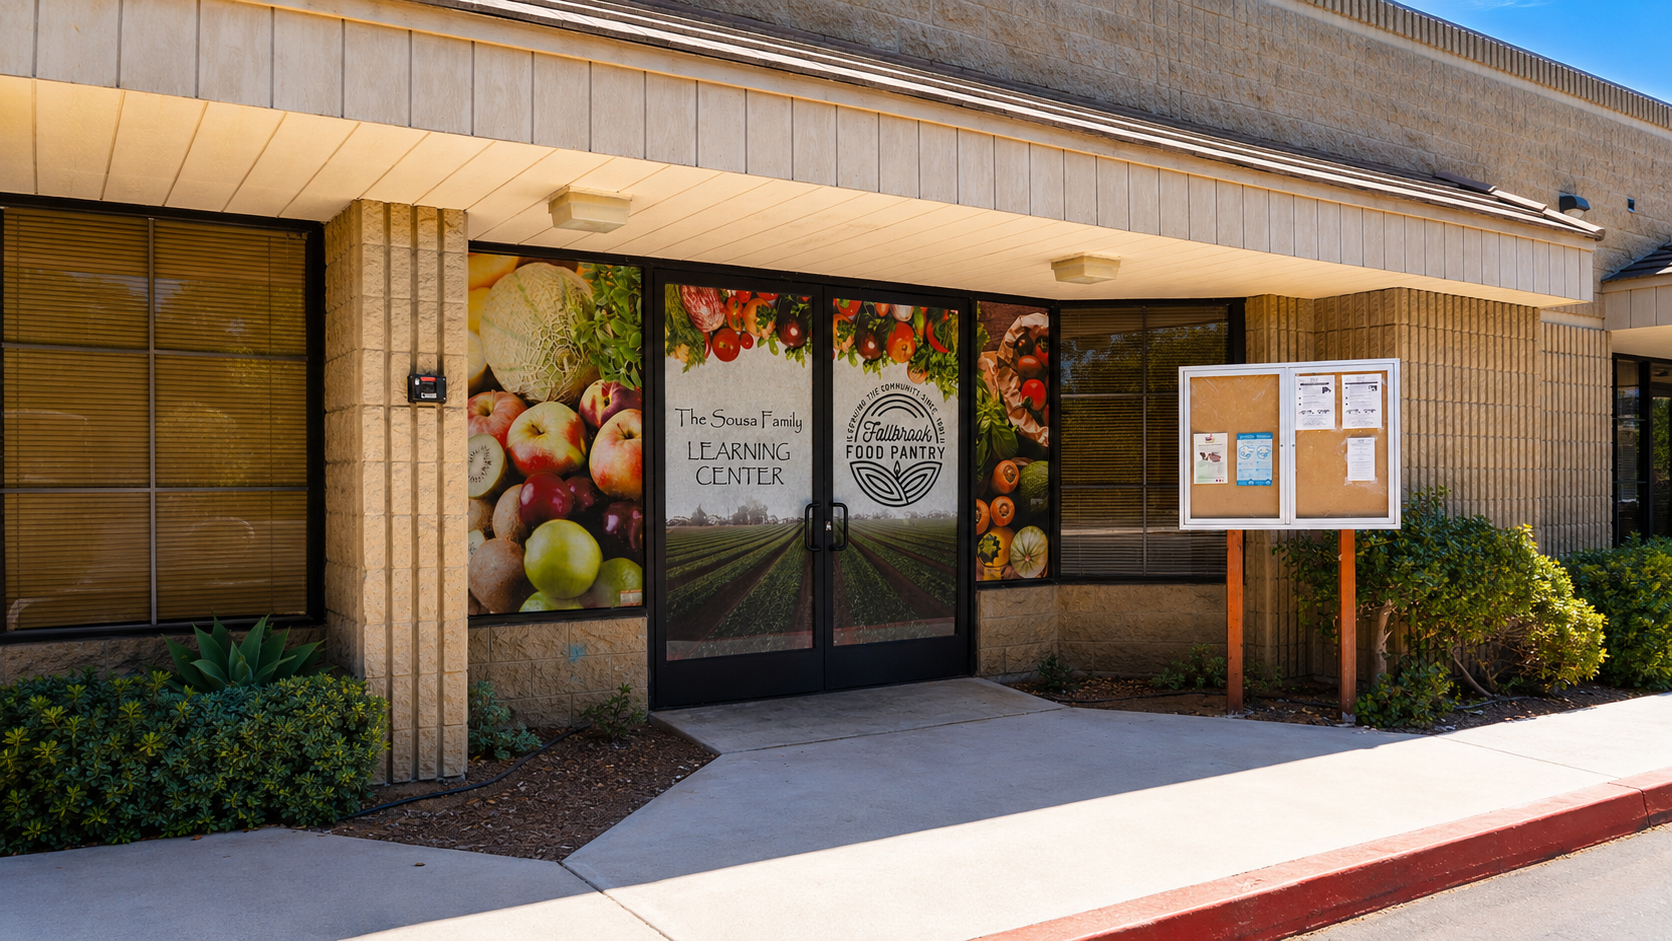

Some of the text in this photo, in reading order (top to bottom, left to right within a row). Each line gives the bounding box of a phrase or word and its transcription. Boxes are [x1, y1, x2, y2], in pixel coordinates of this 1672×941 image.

[866, 387, 880, 401] THE
[675, 408, 802, 433] The Sousa Family
[862, 420, 933, 443] Fallbrook
[687, 441, 791, 461] LEARNING
[846, 444, 946, 460] FOOD PANTRY
[695, 465, 785, 485] CENTER
